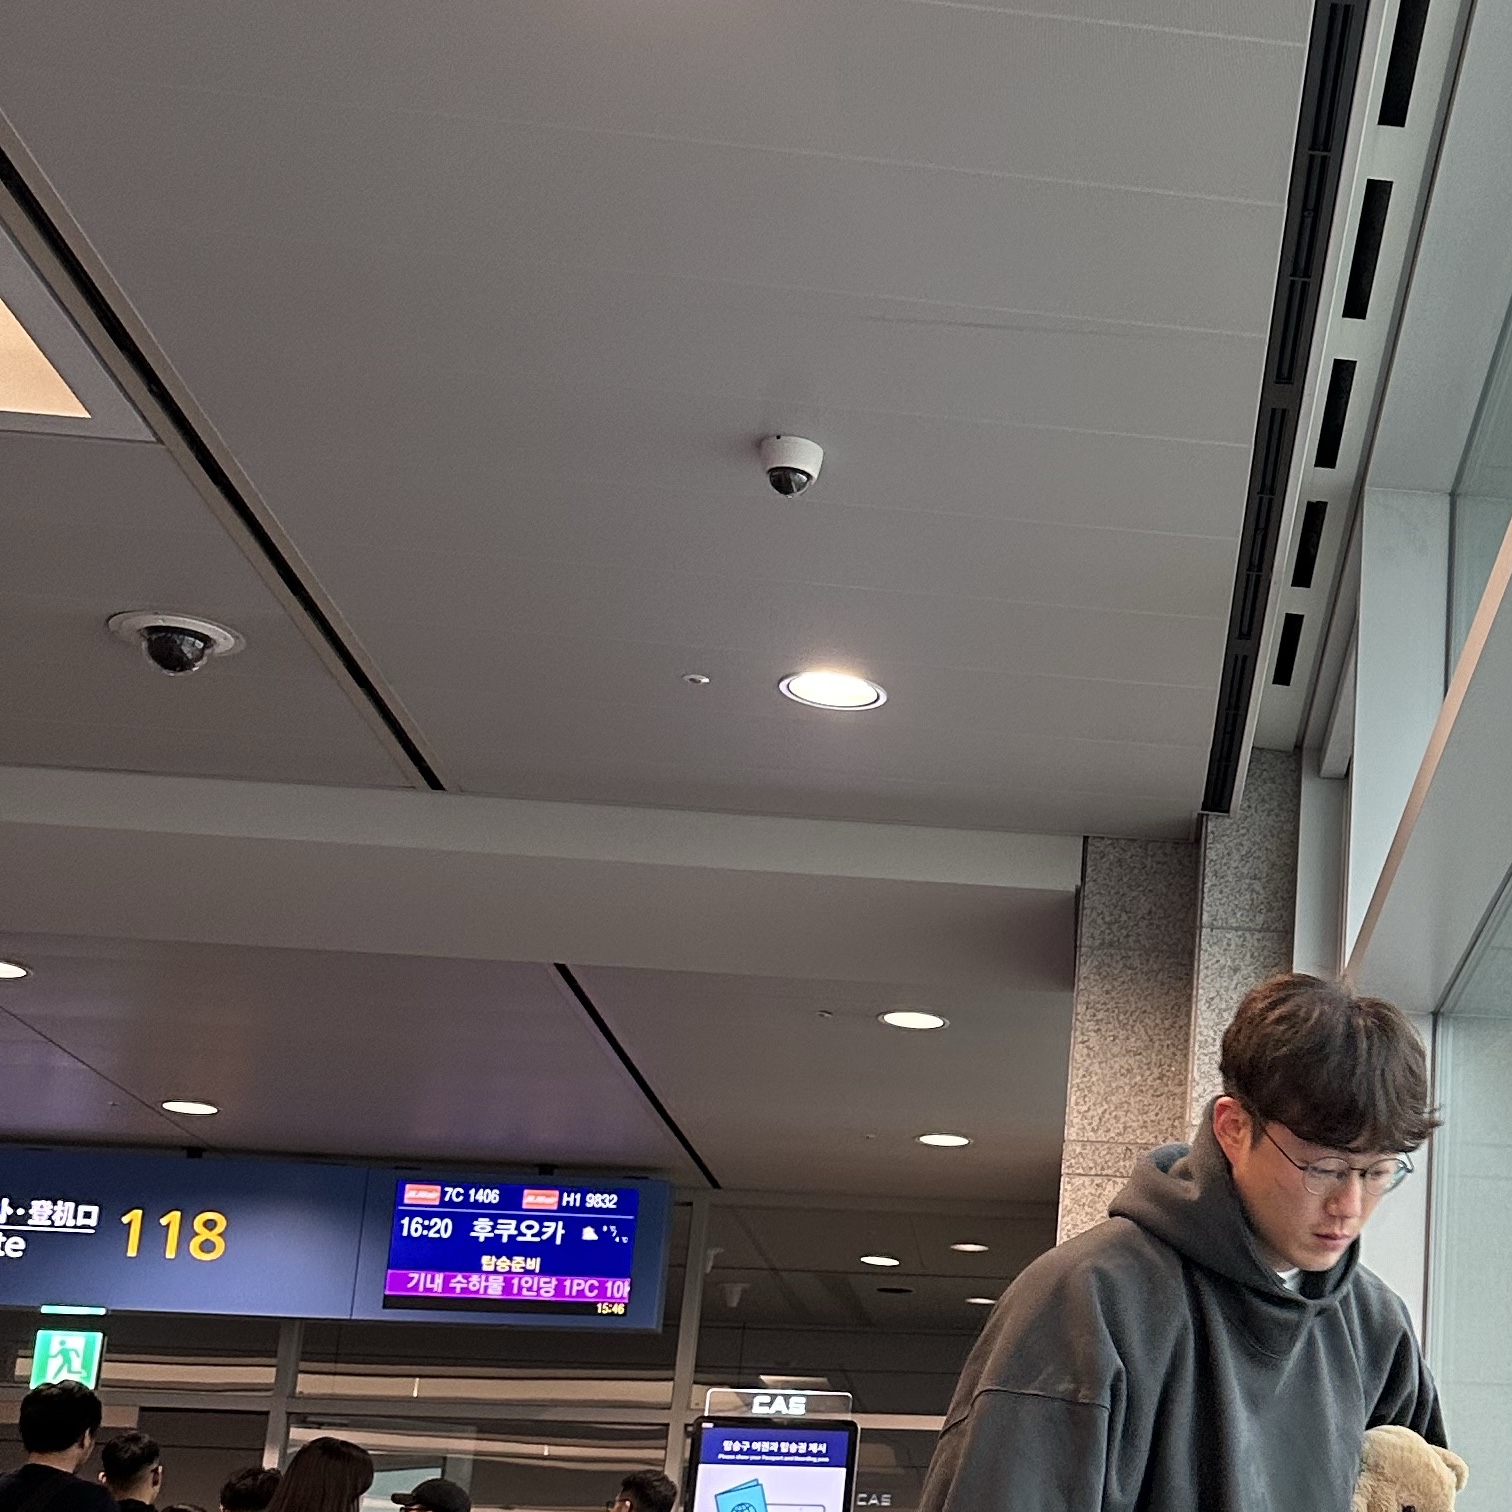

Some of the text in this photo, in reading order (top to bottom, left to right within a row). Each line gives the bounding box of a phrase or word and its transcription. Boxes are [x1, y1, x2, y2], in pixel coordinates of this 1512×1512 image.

[444, 1187, 464, 1202] 7C
[468, 1188, 500, 1203] 1406
[562, 1192, 581, 1207] H1
[585, 1193, 618, 1208] 9832
[120, 1208, 228, 1261] 118
[400, 1216, 566, 1246] 16:20 후쿠오카
[480, 1254, 541, 1273] 탑승준비
[406, 1272, 443, 1292] 기내
[449, 1274, 505, 1295] 수하물
[511, 1276, 558, 1297] 1인당
[564, 1278, 599, 1298] 1PC
[752, 1395, 807, 1415] CAS
[856, 1493, 892, 1506] CAS
